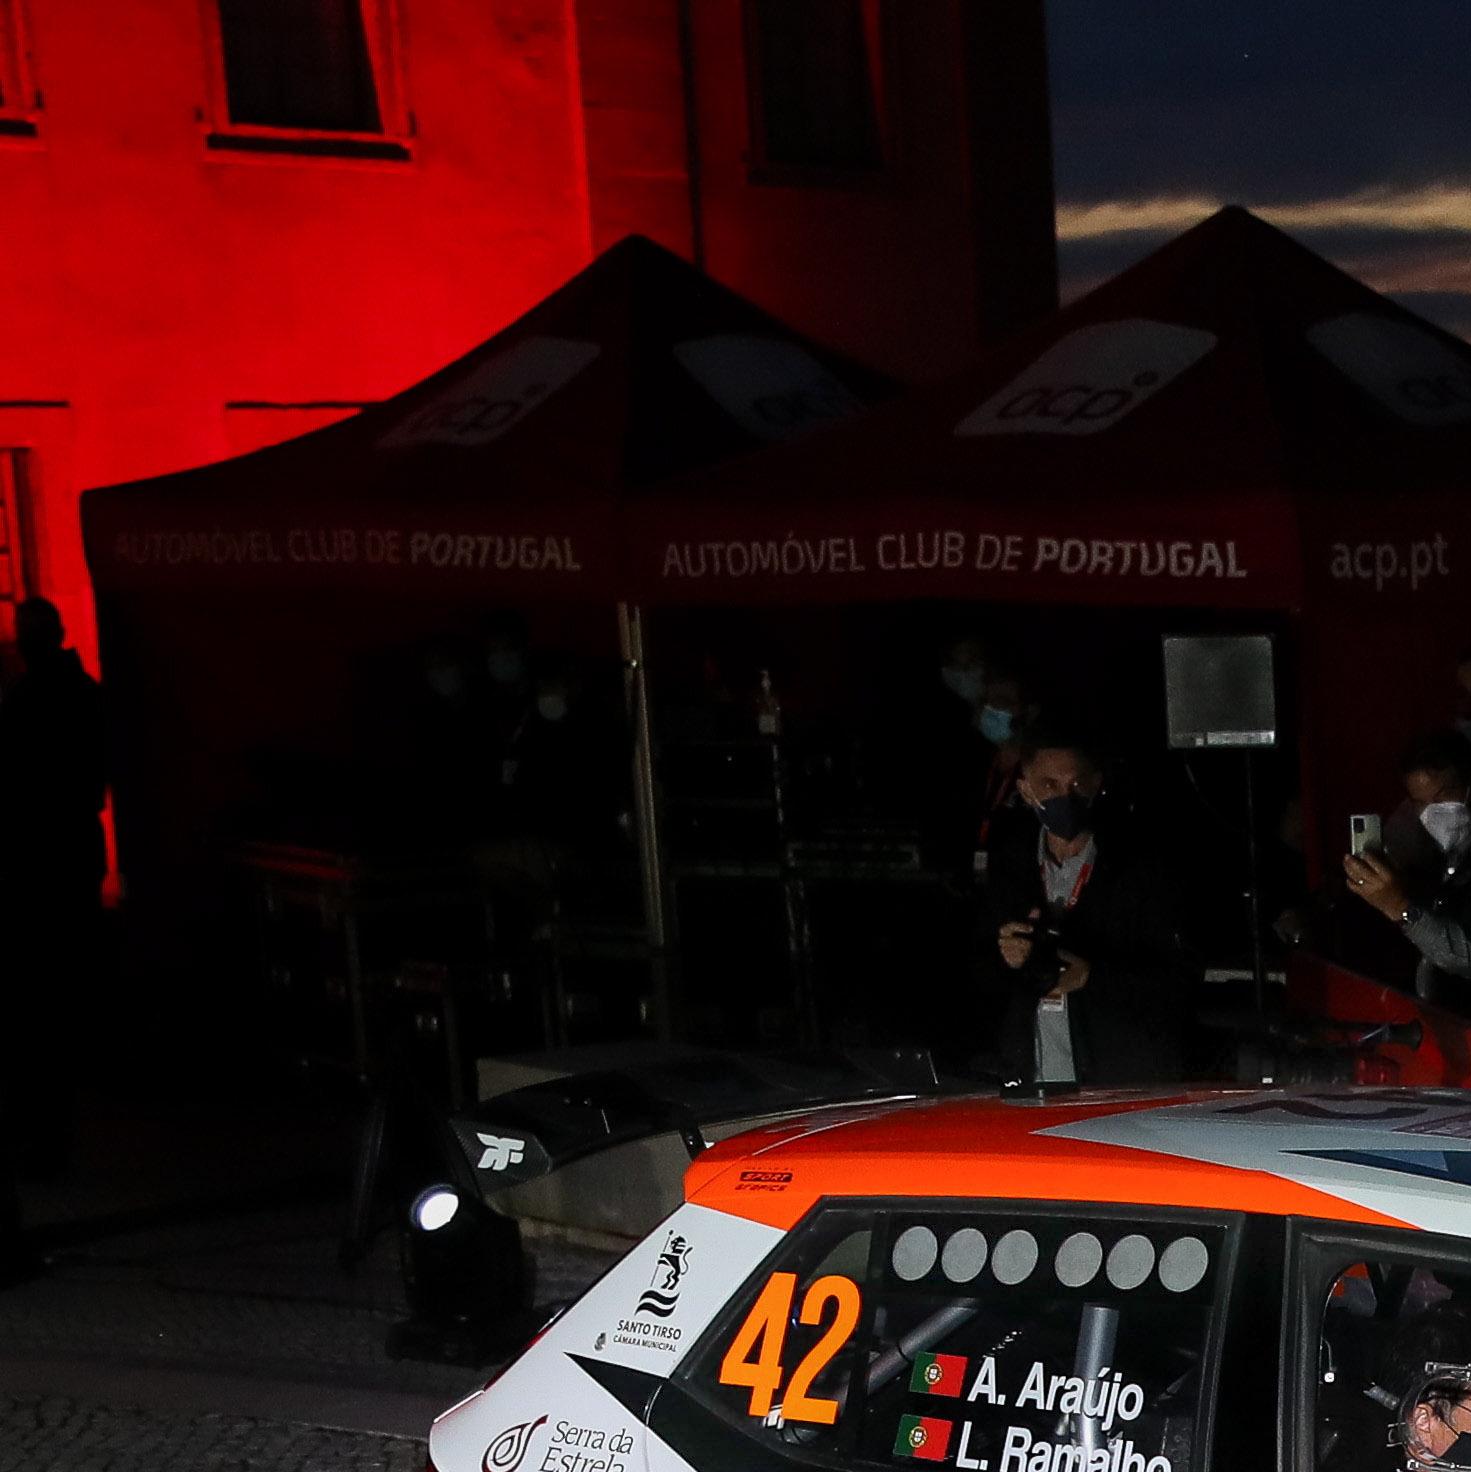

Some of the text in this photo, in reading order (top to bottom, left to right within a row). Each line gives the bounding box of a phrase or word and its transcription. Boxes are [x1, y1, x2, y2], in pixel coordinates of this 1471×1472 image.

[999, 387, 1133, 424] acp
[288, 525, 358, 564] CLUB
[366, 527, 400, 565] DE
[408, 529, 584, 572] PORTUGAL
[662, 530, 1249, 580] AUTOMÓVEL CLUB DE PORTUGAL
[1329, 533, 1451, 592] acp.pt
[616, 1319, 682, 1340] SANTO TIRSO
[719, 1271, 863, 1426] 42
[967, 1355, 1145, 1433] A. Araújo
[551, 1420, 634, 1455] Serra da
[954, 1420, 989, 1472] L.
